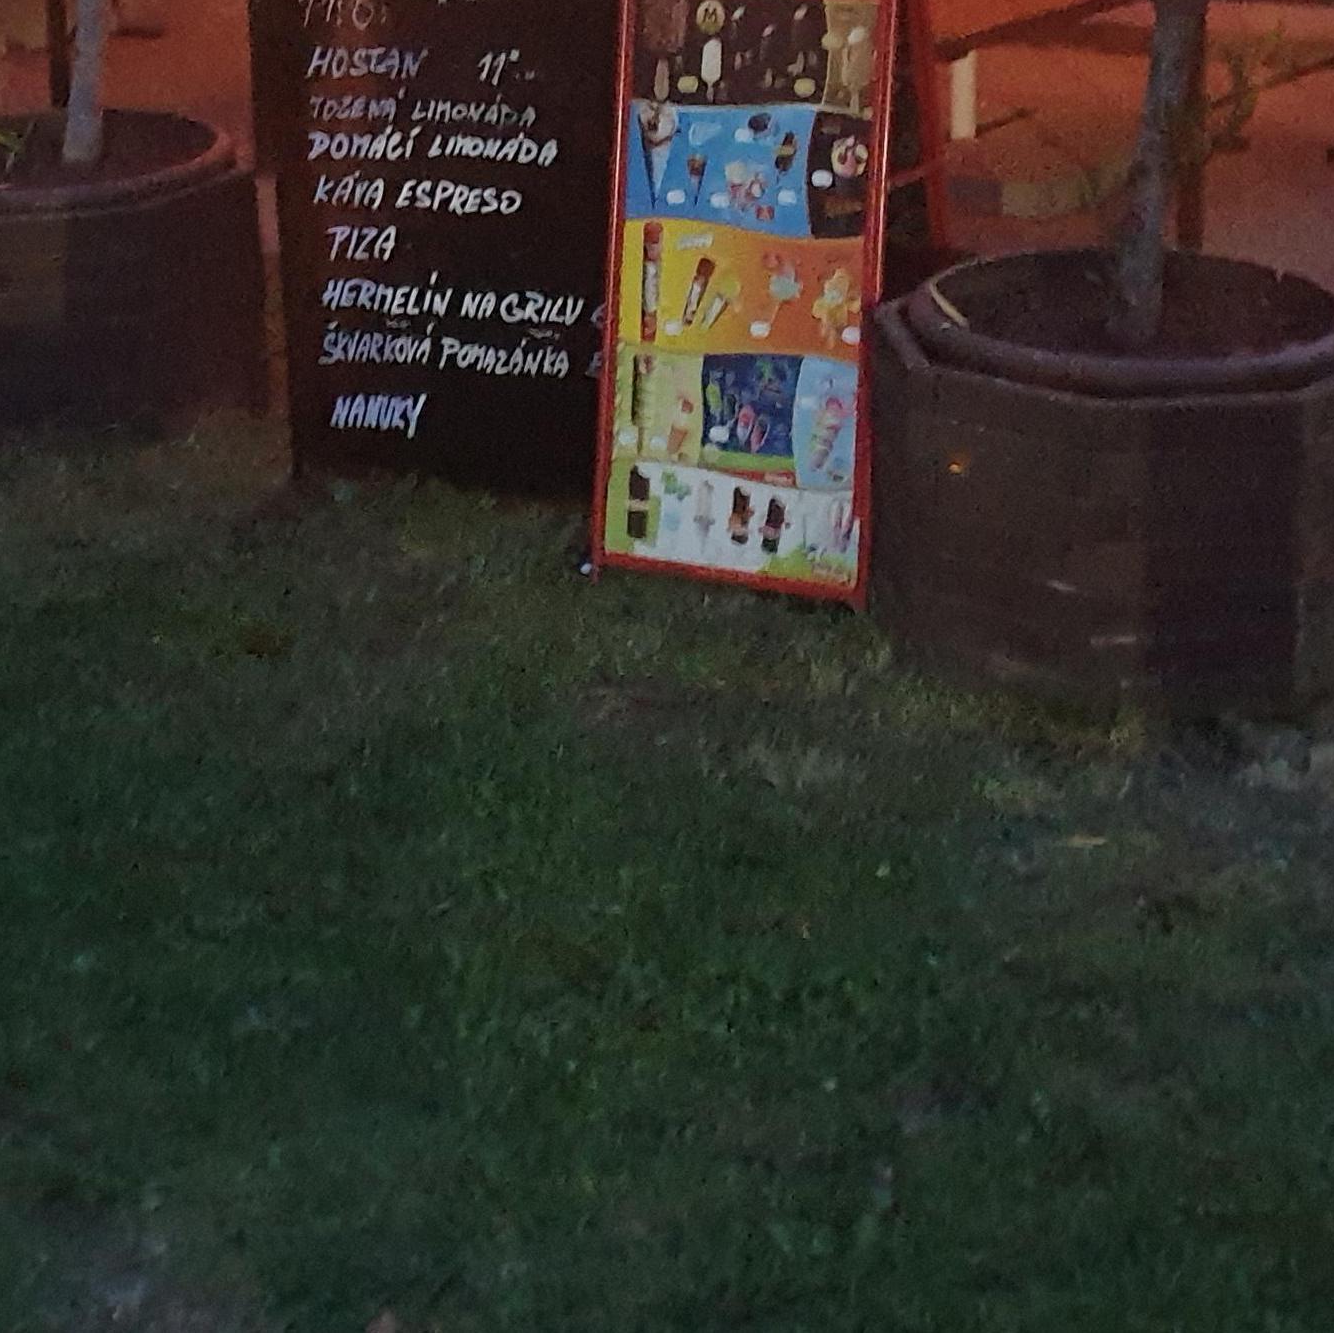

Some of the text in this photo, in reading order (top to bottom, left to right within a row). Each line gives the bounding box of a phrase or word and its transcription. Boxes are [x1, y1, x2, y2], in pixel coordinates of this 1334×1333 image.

[306, 46, 428, 78] HOSTAN
[428, 132, 559, 167] LIMONÁDA
[313, 170, 523, 216] KÁVA ESPRESO
[326, 224, 397, 261] PIZA
[321, 271, 453, 318] HERMELÍN
[460, 290, 497, 319] NA
[439, 336, 570, 378] POMAZÁNKA
